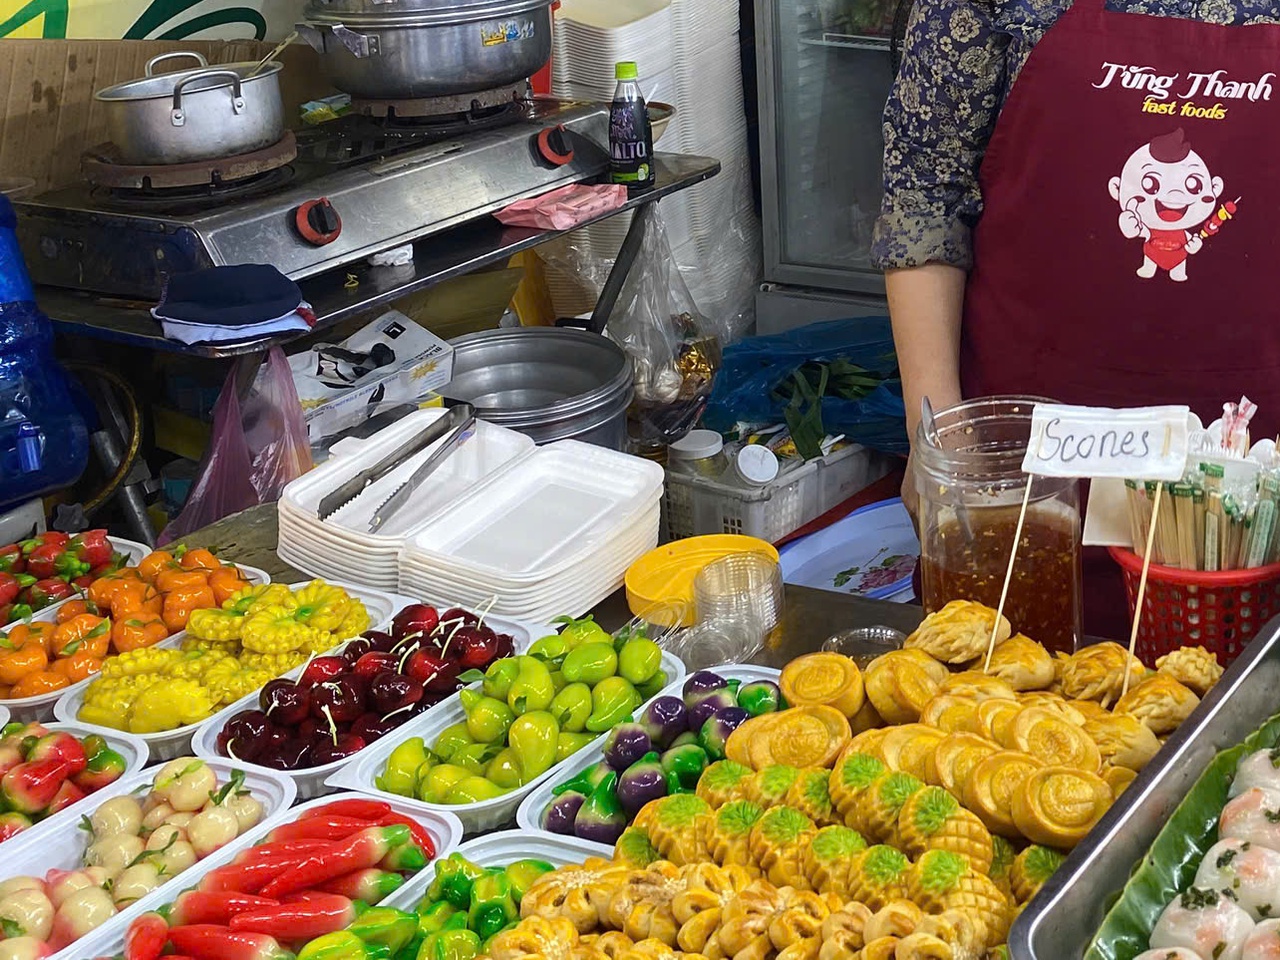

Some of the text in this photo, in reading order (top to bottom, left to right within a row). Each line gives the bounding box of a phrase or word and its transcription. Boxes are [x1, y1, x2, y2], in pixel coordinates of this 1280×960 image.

[1177, 69, 1277, 103] Thanh
[1141, 97, 1229, 120] fast foods
[1041, 418, 1150, 462] Scones
